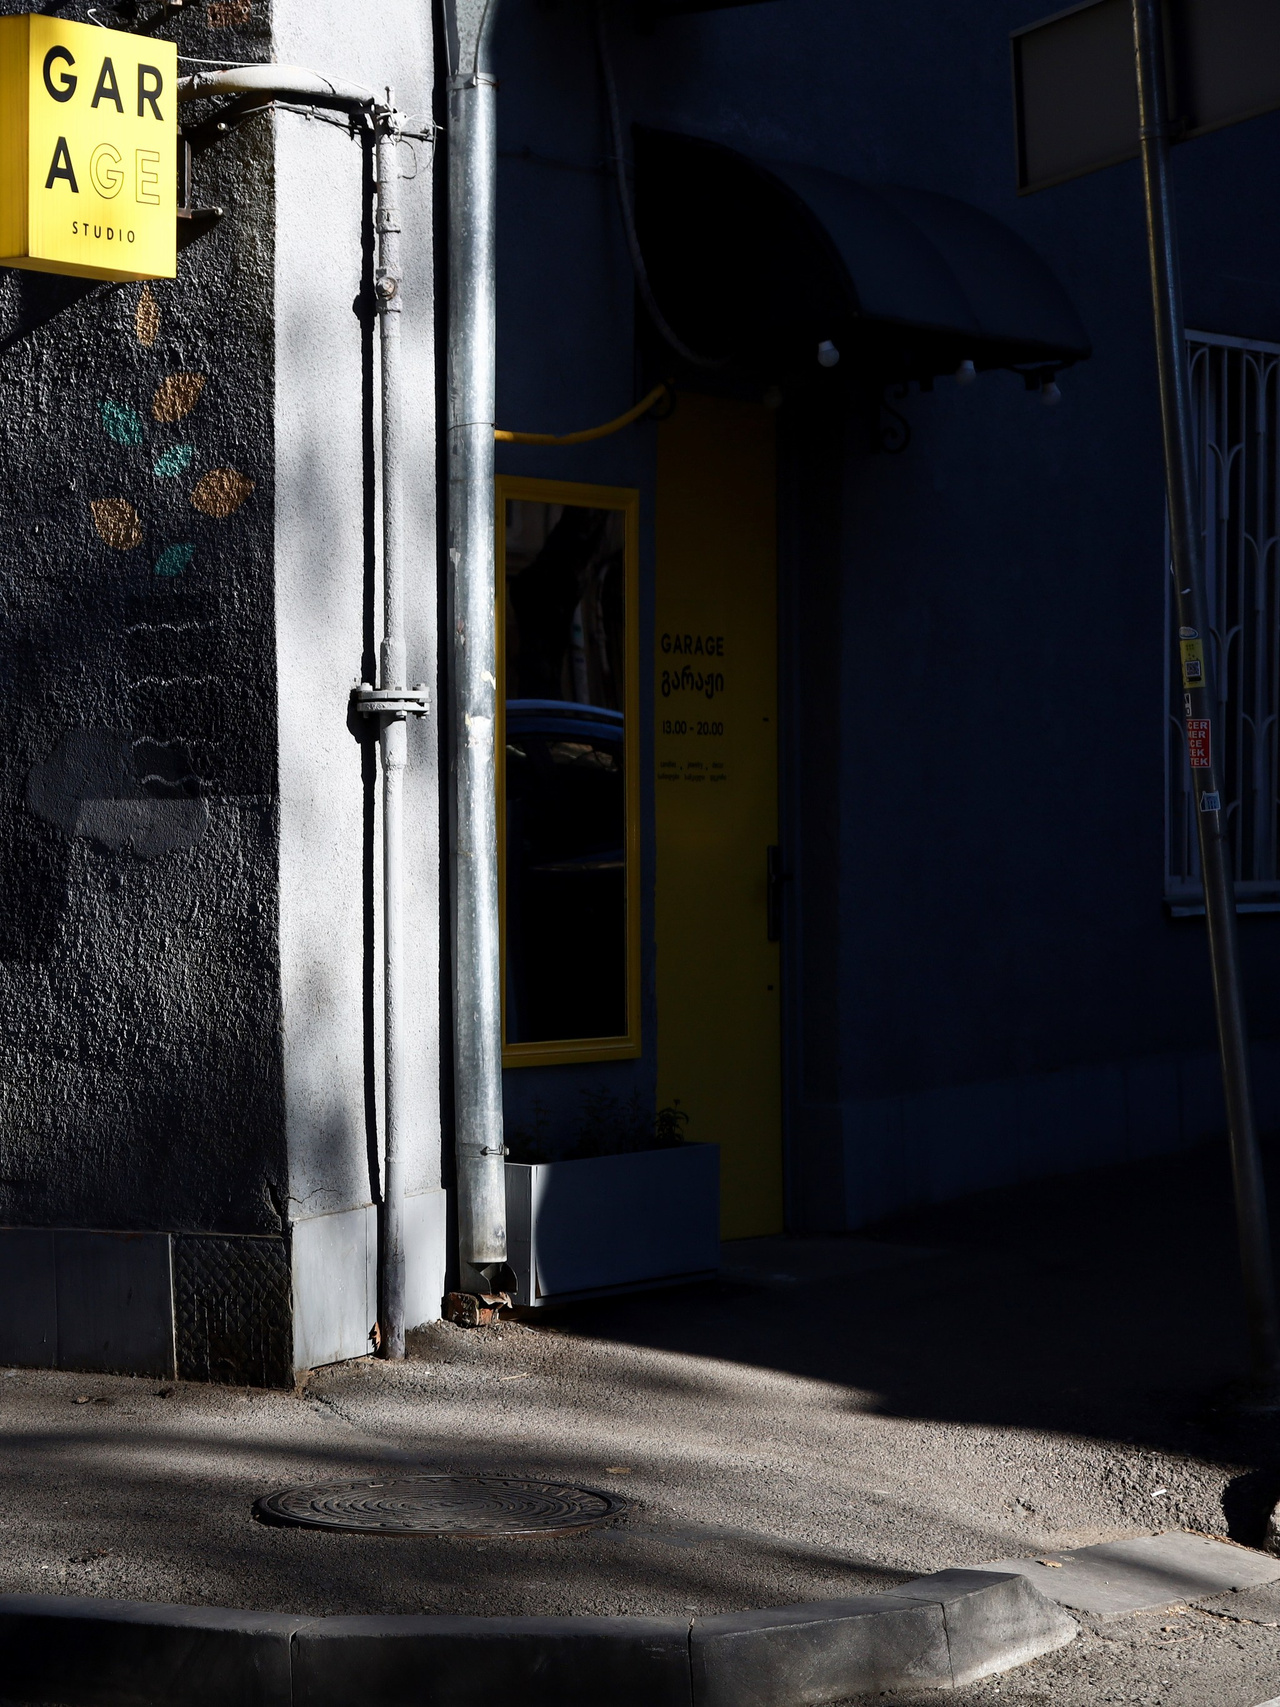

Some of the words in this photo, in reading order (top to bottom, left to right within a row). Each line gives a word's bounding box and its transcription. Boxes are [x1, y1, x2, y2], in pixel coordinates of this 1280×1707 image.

[43, 45, 164, 121] GAR
[45, 136, 160, 205] AGE
[72, 221, 135, 243] STUDIO
[661, 633, 724, 656] GARAGE
[661, 664, 724, 699] გარაჟი
[662, 720, 687, 735] 13.00
[696, 721, 724, 736] 20.00
[1189, 748, 1205, 757] EK
